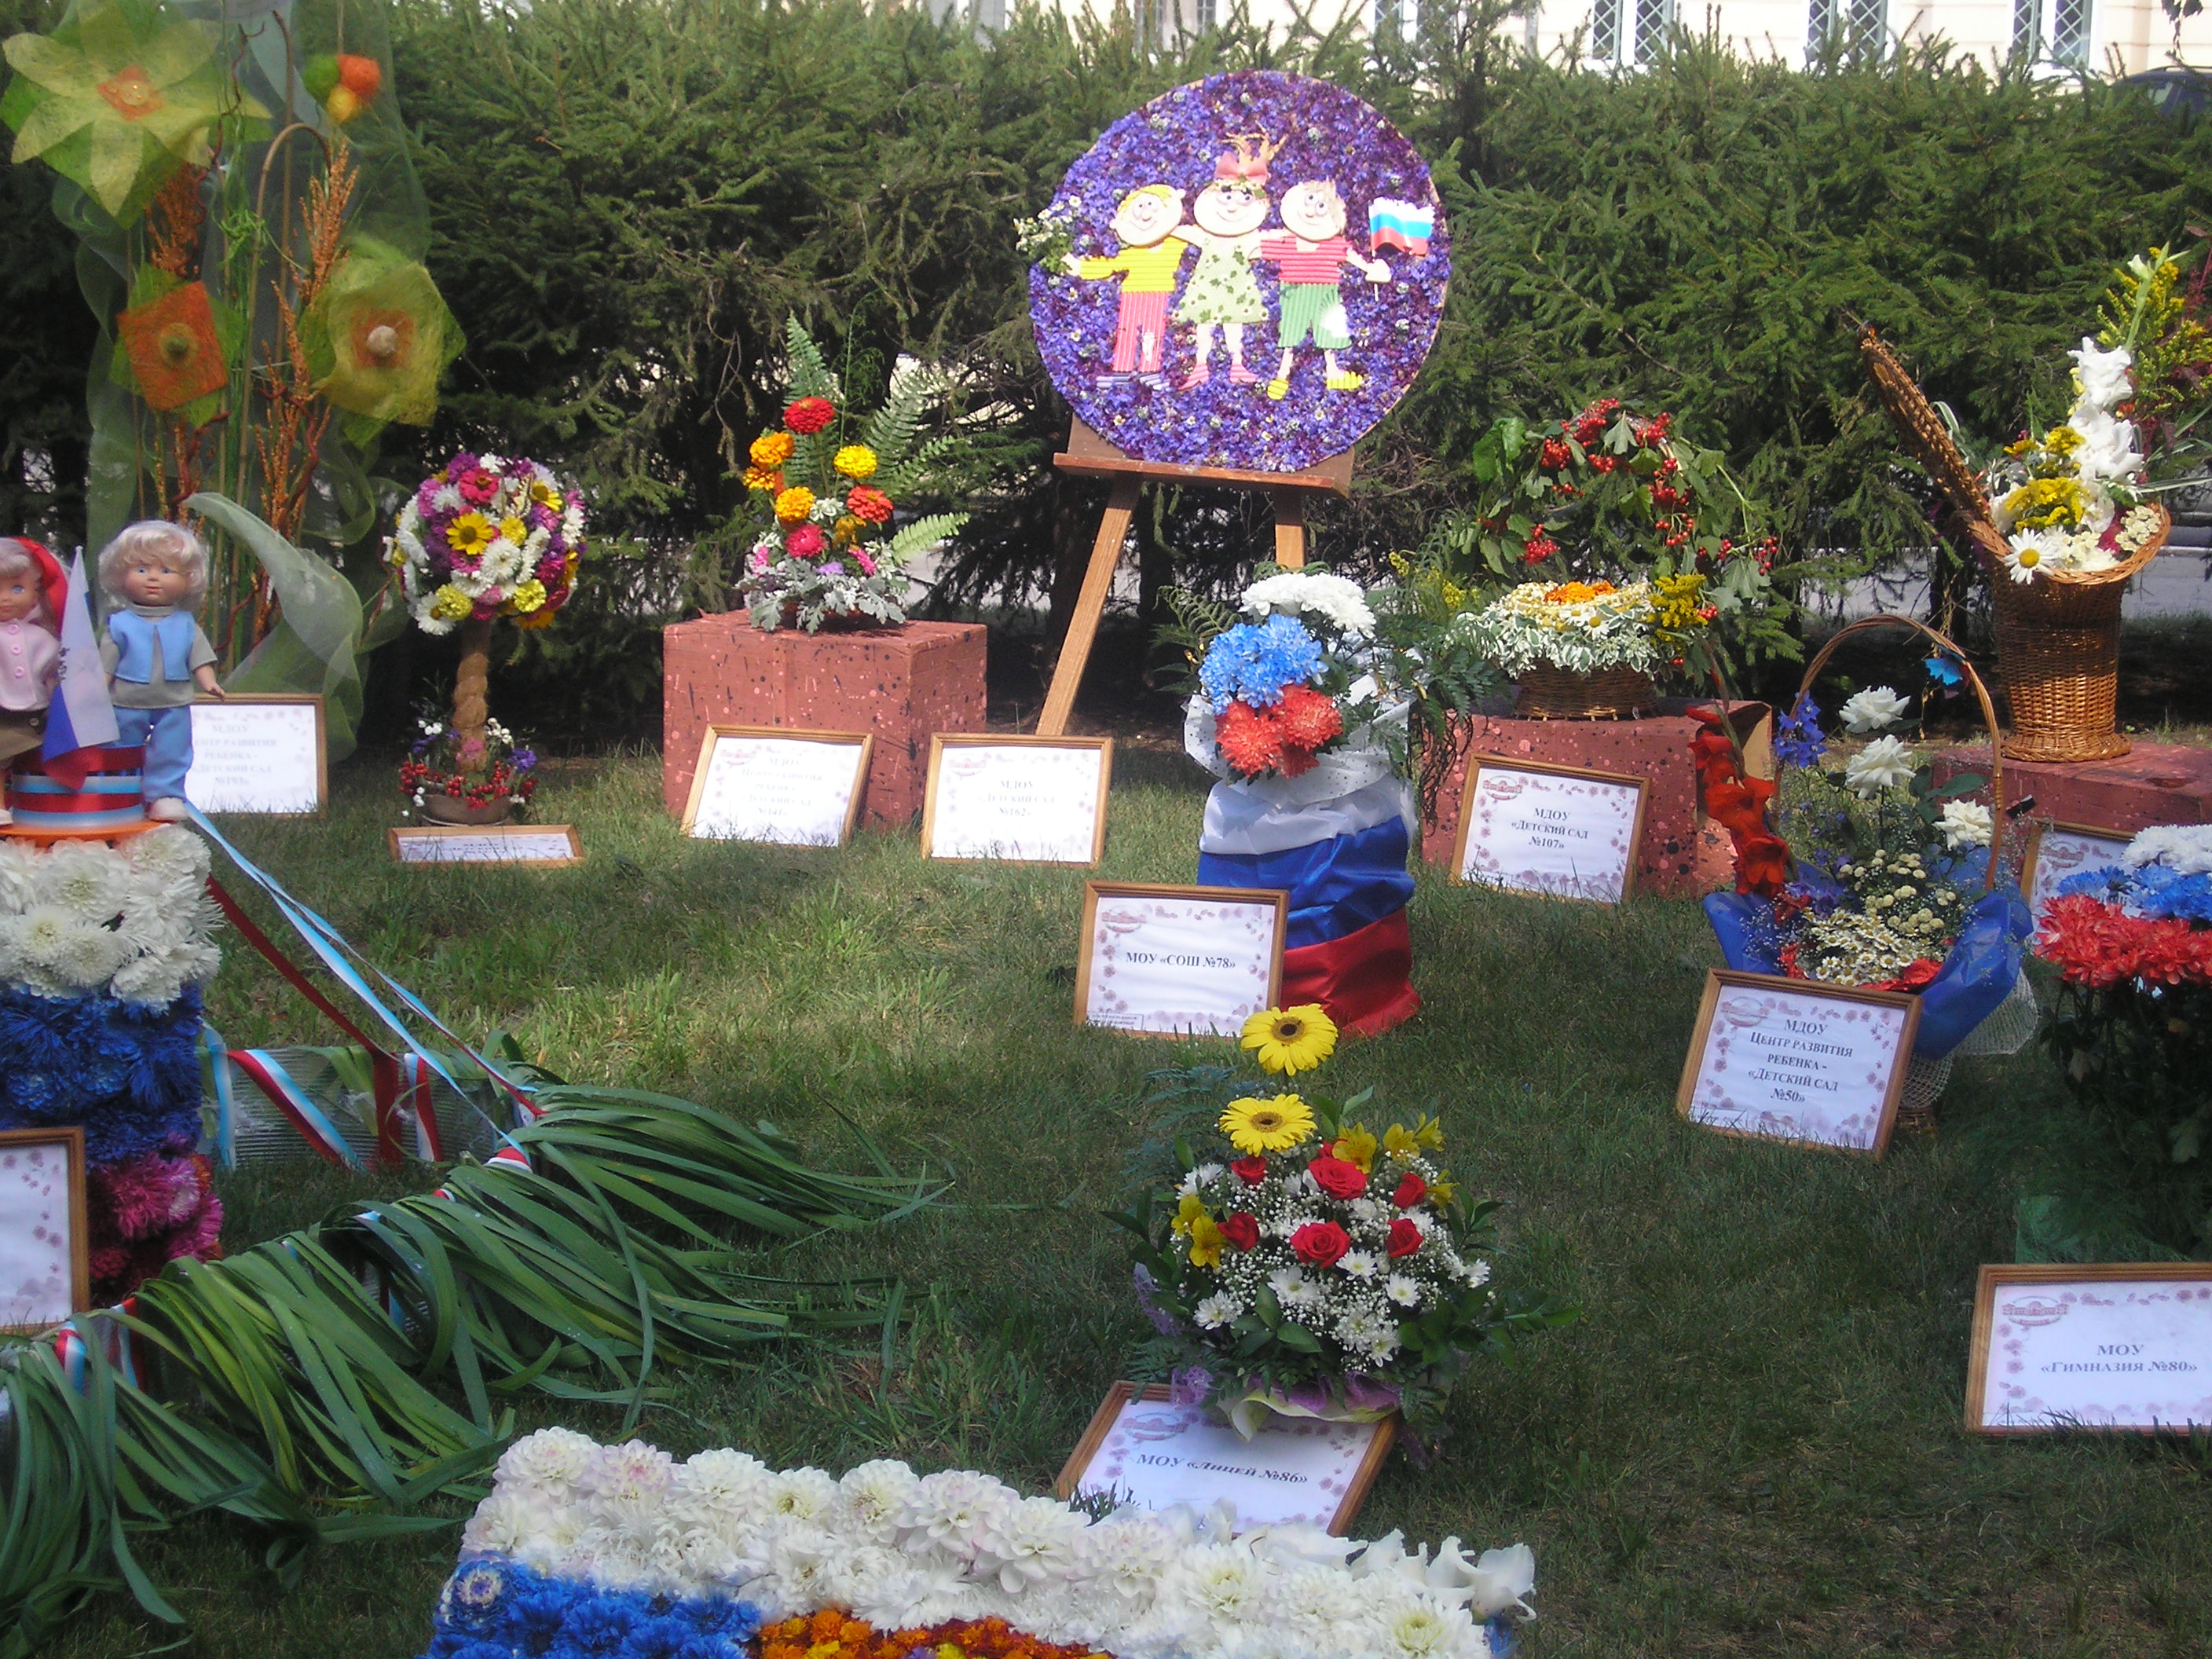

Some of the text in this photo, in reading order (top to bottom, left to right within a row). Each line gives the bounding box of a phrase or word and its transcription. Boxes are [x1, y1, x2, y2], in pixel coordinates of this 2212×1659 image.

[1533, 807, 1571, 822] МДОУ
[1528, 836, 1566, 850] №107»
[1126, 951, 1236, 969] МОУ «СОШ №78»
[1783, 1018, 1829, 1035] МДОУ
[1769, 1087, 1806, 1103] №50»
[2097, 1343, 2144, 1356] МОУ
[2148, 1361, 2199, 1372] №80»
[1137, 1453, 1185, 1469] МОУ
[1259, 1469, 1309, 1485] №86»
